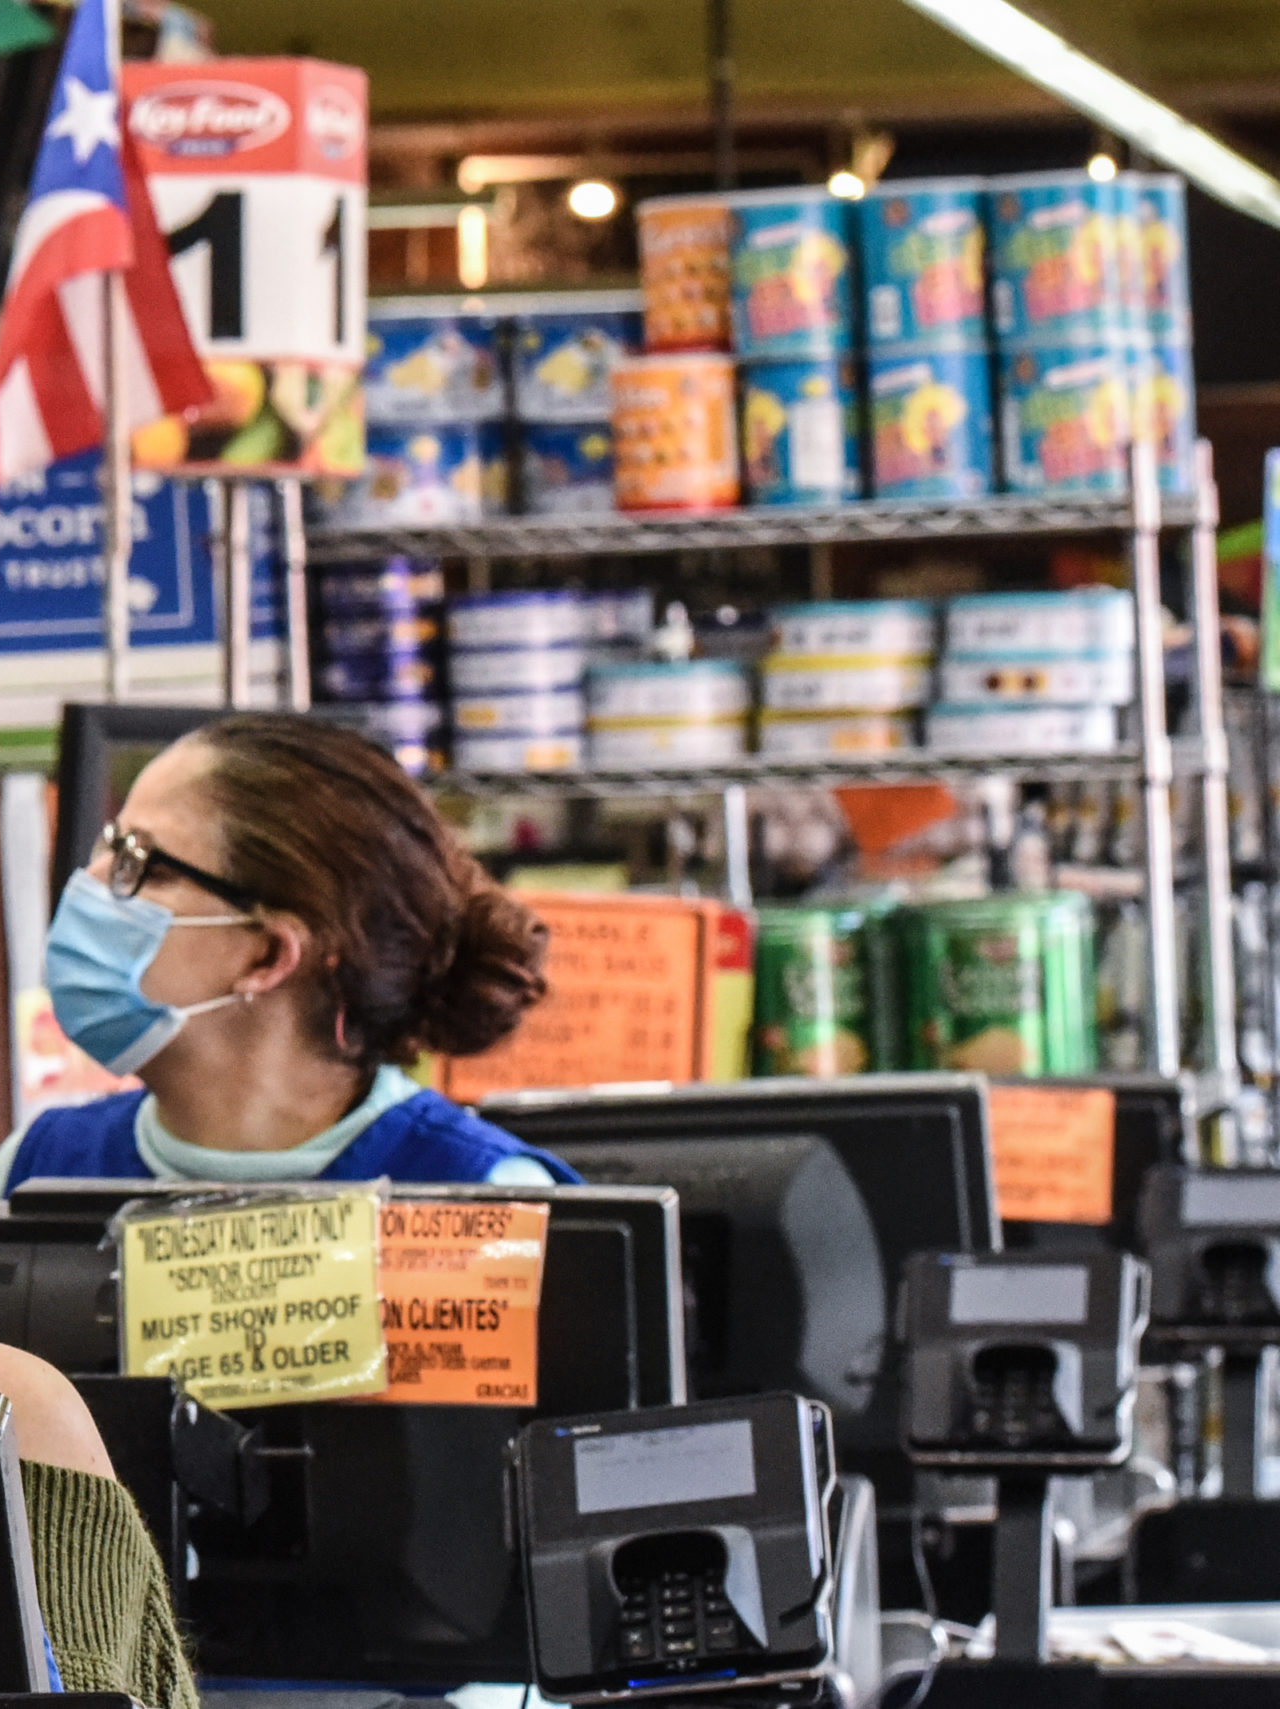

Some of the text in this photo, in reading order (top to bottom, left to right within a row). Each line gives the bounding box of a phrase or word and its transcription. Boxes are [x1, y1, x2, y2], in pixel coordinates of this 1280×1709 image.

[168, 190, 242, 340] 1
[141, 1314, 201, 1341] MUST
[210, 1305, 277, 1334] SHOW
[284, 1294, 361, 1324] PROOF
[220, 1353, 244, 1376] 65
[272, 1340, 351, 1370] OLDER
